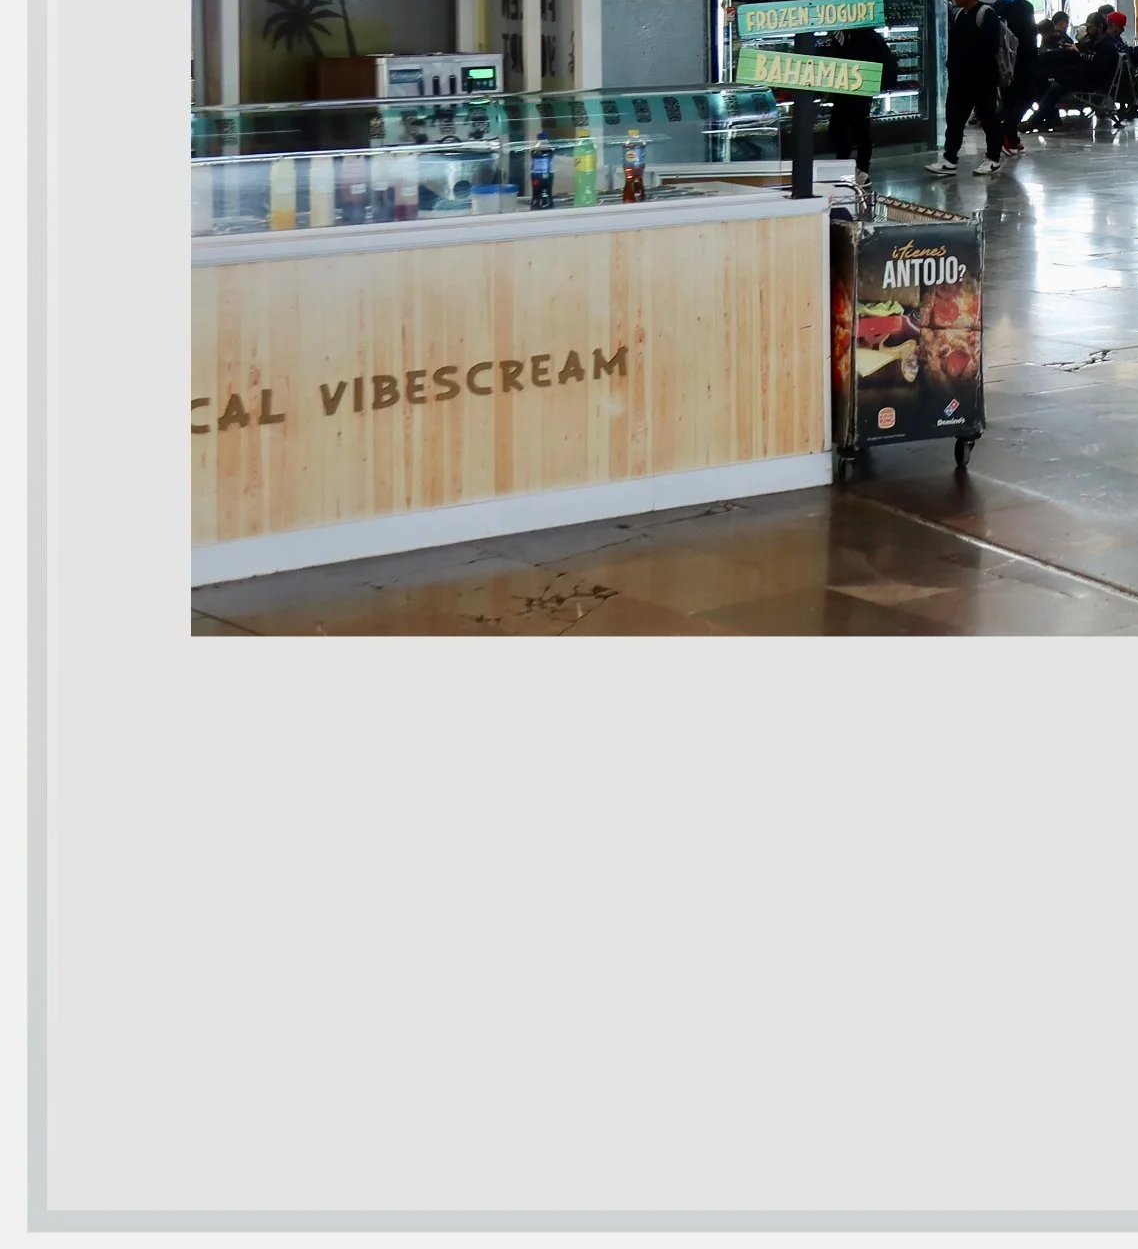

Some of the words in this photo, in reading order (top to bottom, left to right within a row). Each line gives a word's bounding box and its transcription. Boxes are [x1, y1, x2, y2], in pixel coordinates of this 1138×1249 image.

[746, 6, 809, 32] FROZEN
[815, 1, 876, 25] YOGURT
[754, 53, 863, 91] BAHAMAS
[882, 255, 967, 290] ANTOJO?
[320, 345, 629, 416] VIBESCREAM
